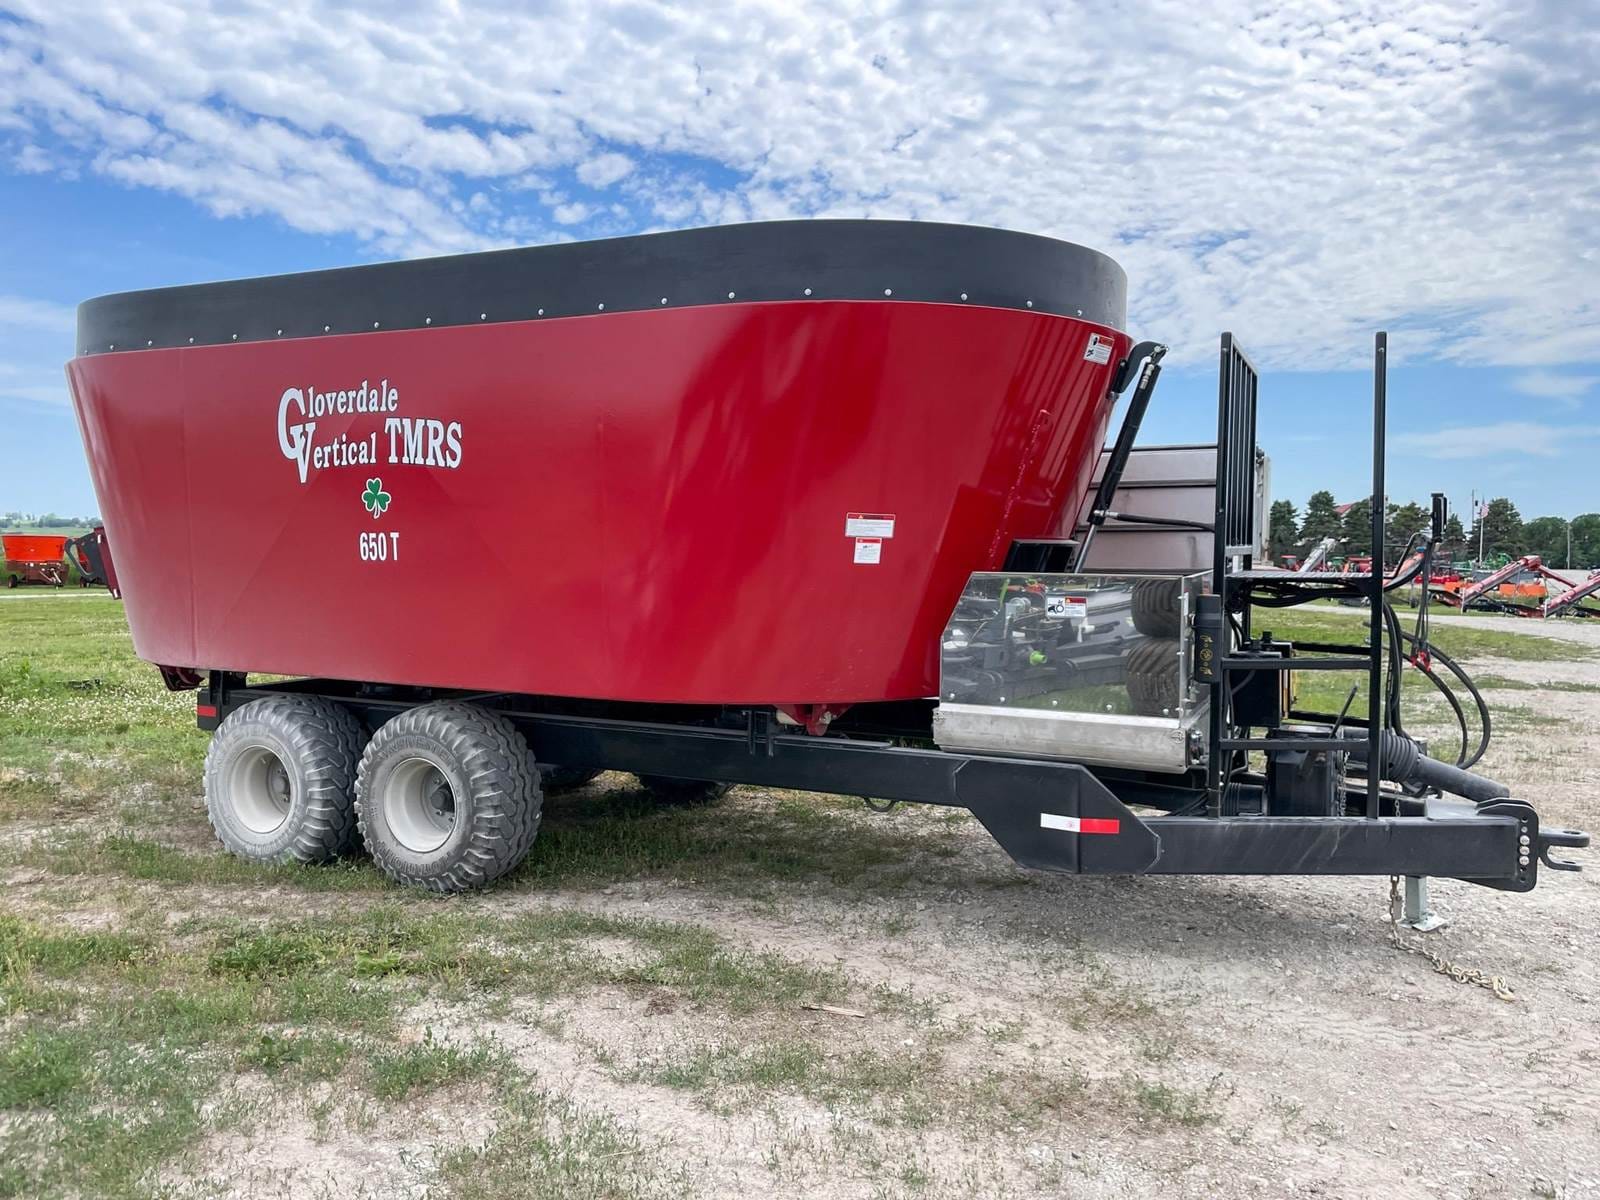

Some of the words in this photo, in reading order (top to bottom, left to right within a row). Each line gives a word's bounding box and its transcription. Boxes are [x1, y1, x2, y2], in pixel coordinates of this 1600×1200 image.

[289, 422, 377, 484] Vertical
[384, 417, 462, 469] TMRS
[359, 532, 387, 561] 650
[390, 532, 400, 561] T
